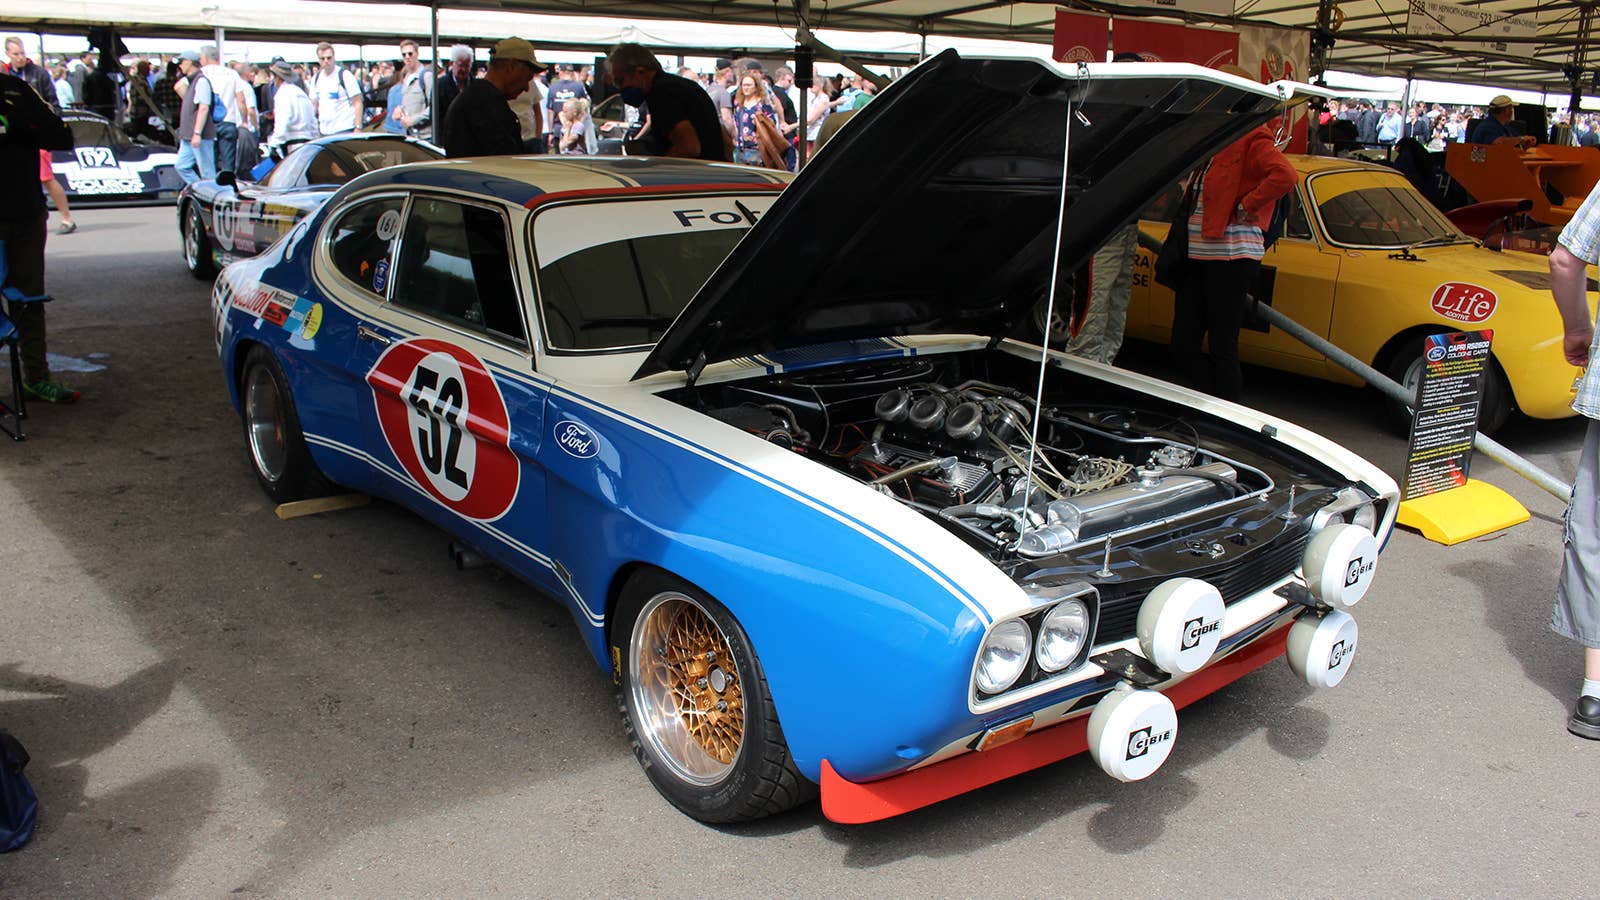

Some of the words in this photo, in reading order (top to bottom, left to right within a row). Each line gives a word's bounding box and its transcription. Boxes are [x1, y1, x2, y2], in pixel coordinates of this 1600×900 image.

[80, 149, 117, 168] 62
[1434, 284, 1491, 318] Life
[1447, 351, 1472, 359] COLOGNE
[1448, 343, 1467, 353] CAPRI
[408, 364, 469, 491] 52
[561, 424, 593, 454] Ford
